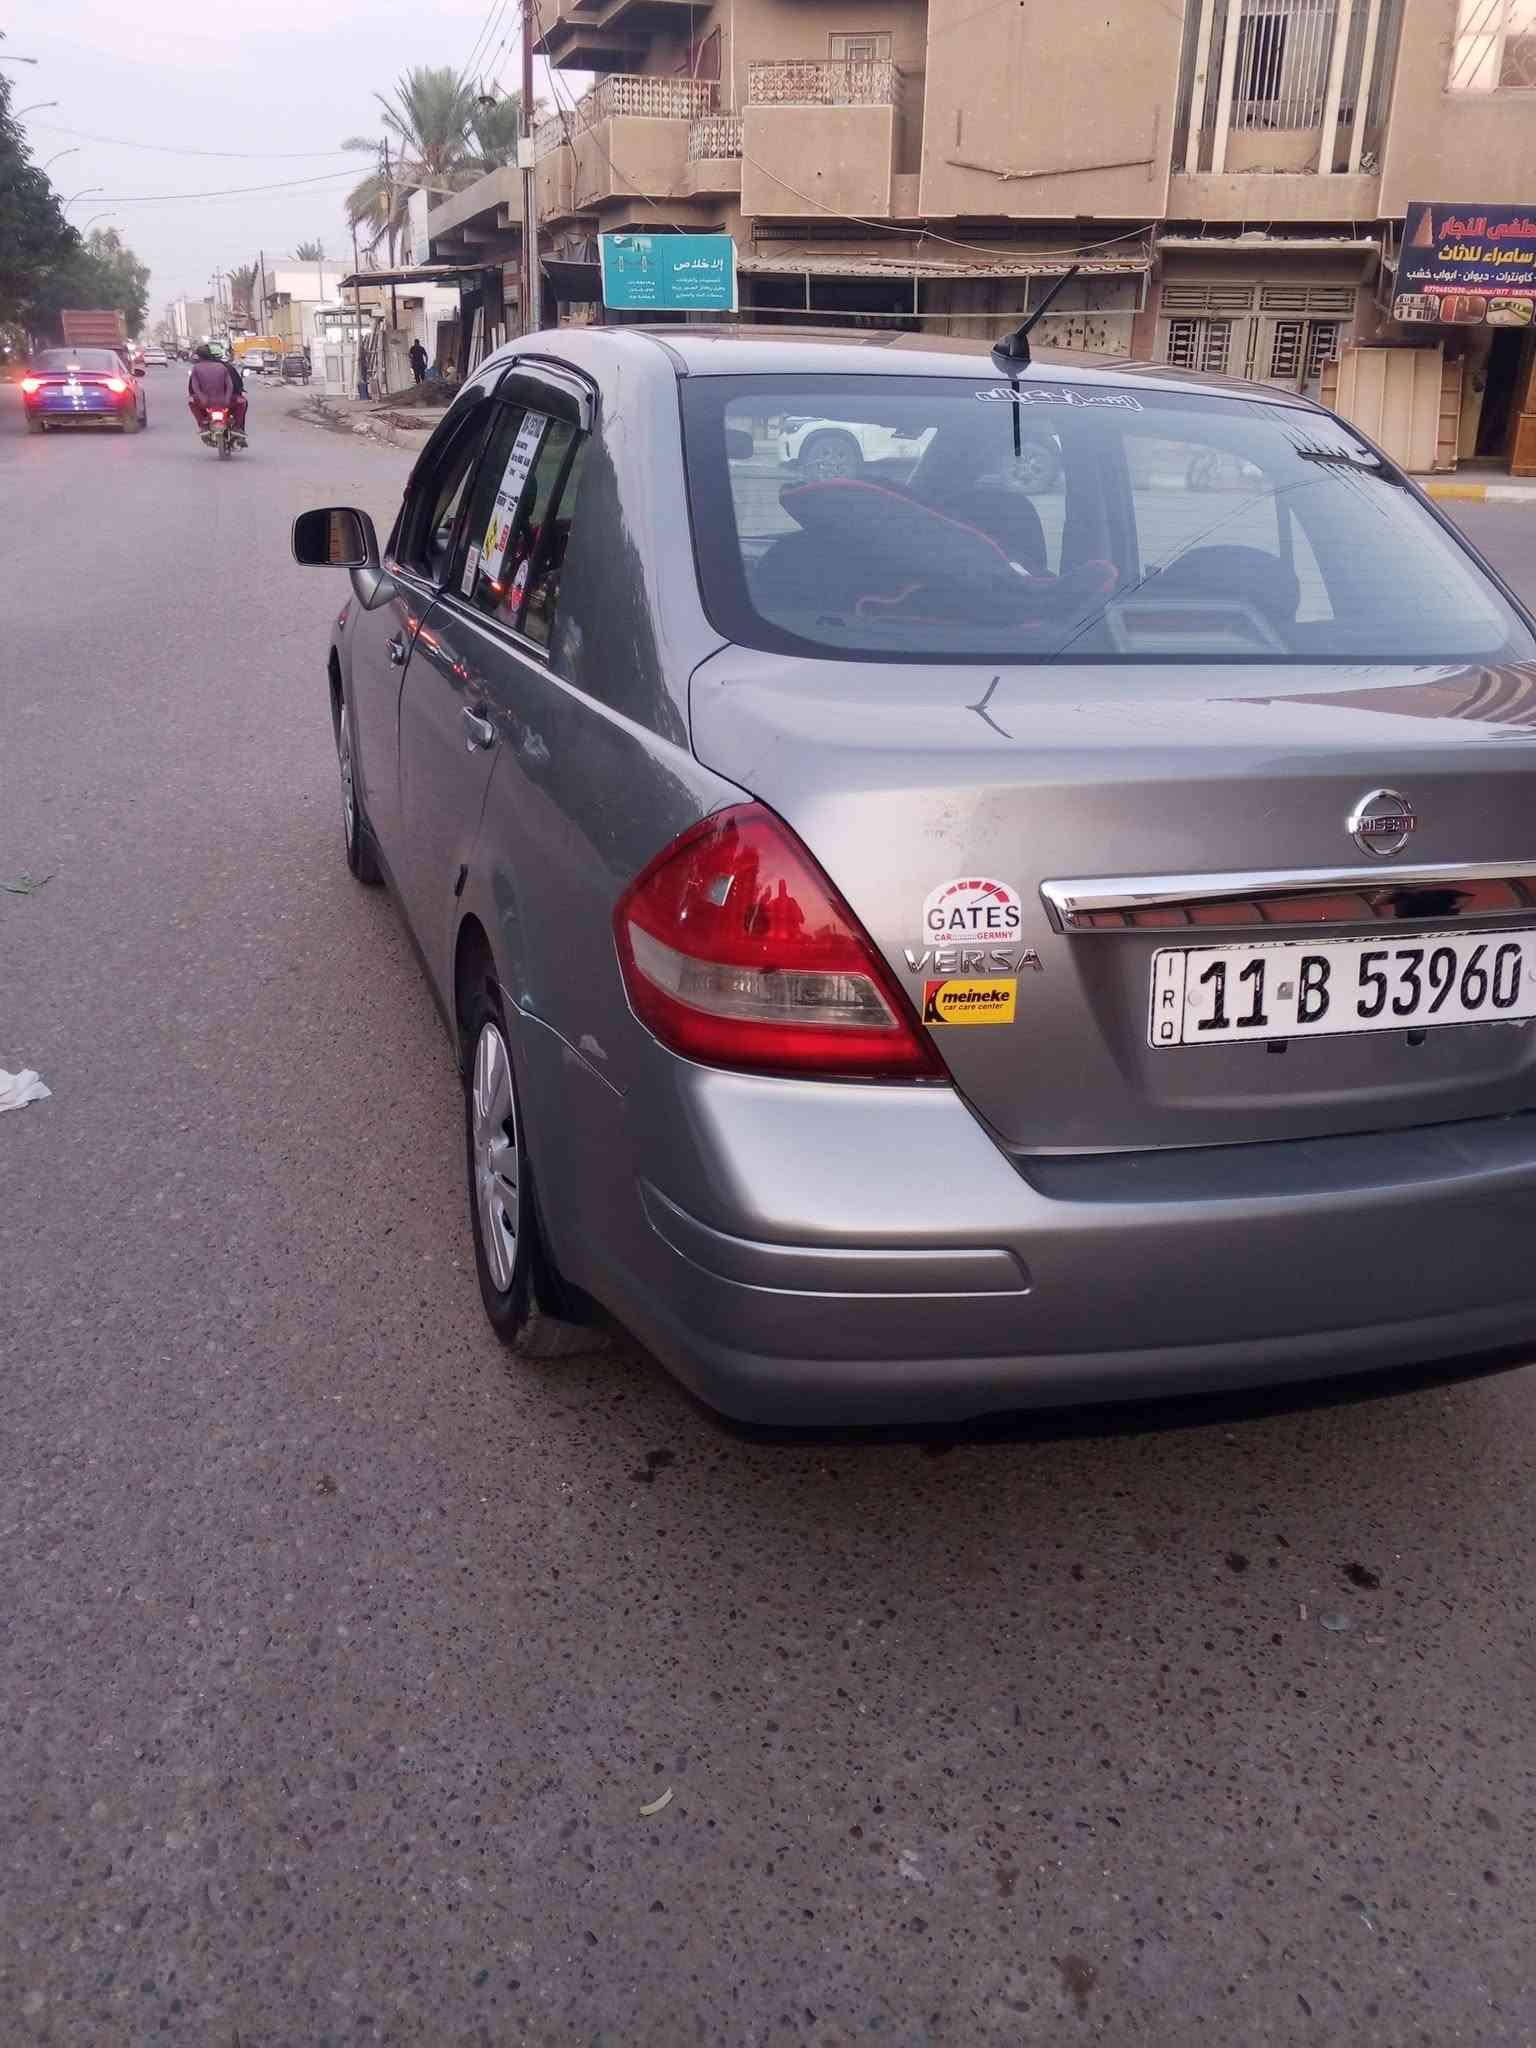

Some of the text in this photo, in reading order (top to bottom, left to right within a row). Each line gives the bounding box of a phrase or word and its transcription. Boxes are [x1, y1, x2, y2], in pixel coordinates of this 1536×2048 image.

[1439, 216, 1487, 240] النجار
[1438, 244, 1482, 262] للاثاث
[1483, 246, 1534, 266] سامراء
[927, 905, 1020, 931] GATES
[903, 947, 1045, 974] VERSA
[942, 988, 1010, 1004] meineke
[1197, 943, 1523, 1031] 11 B 53960
[943, 1002, 1004, 1012] car care center
